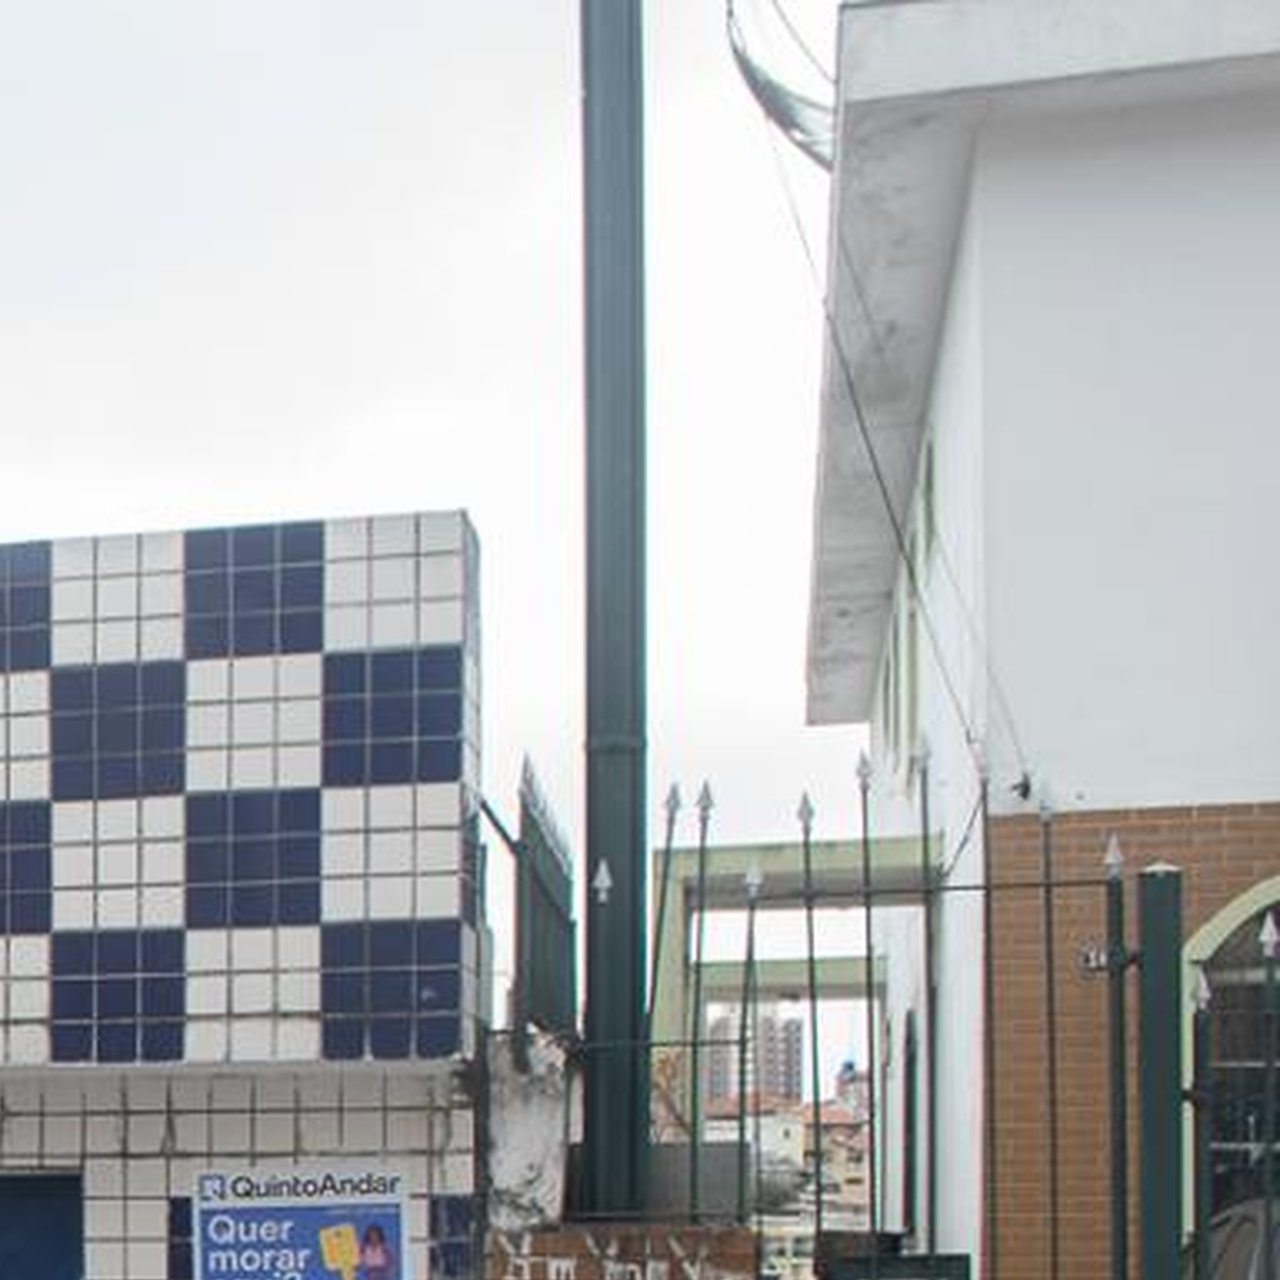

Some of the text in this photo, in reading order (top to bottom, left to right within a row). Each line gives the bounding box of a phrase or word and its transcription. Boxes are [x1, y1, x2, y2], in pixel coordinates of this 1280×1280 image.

[231, 1173, 400, 1199] QuintoAndar
[208, 1215, 293, 1244] Quer
[208, 1249, 311, 1272] morar
